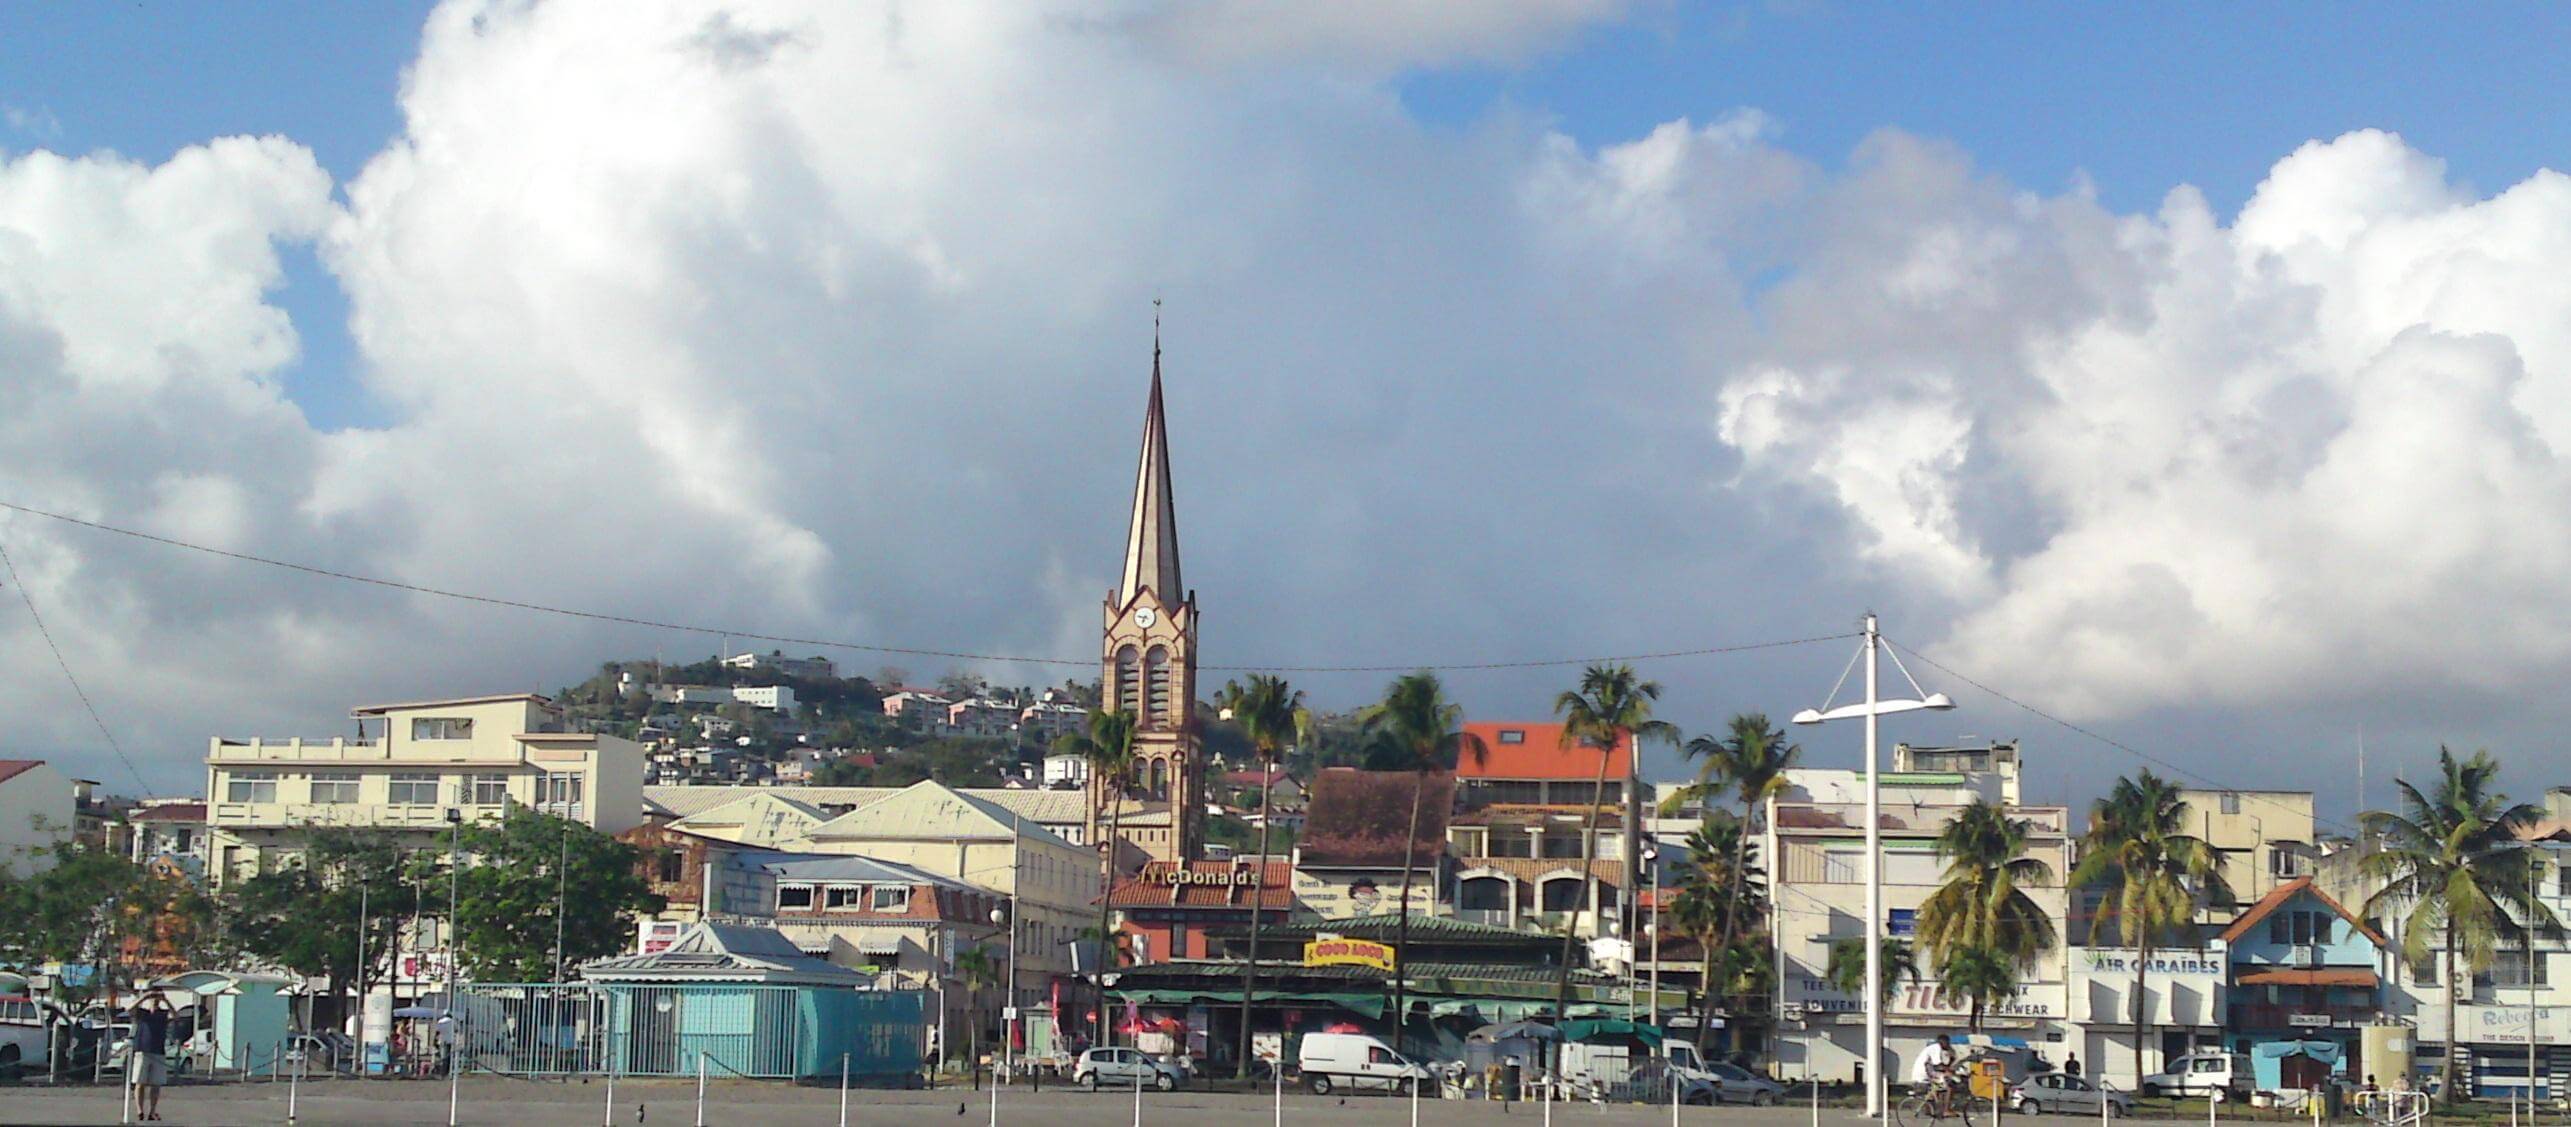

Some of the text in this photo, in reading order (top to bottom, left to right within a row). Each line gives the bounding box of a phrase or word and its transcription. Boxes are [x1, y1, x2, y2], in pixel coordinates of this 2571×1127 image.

[1316, 943, 1384, 960] COCO LOCO
[2095, 956, 2219, 974] AIR CARAÏBES
[1803, 999, 1867, 1011] SOUVENI
